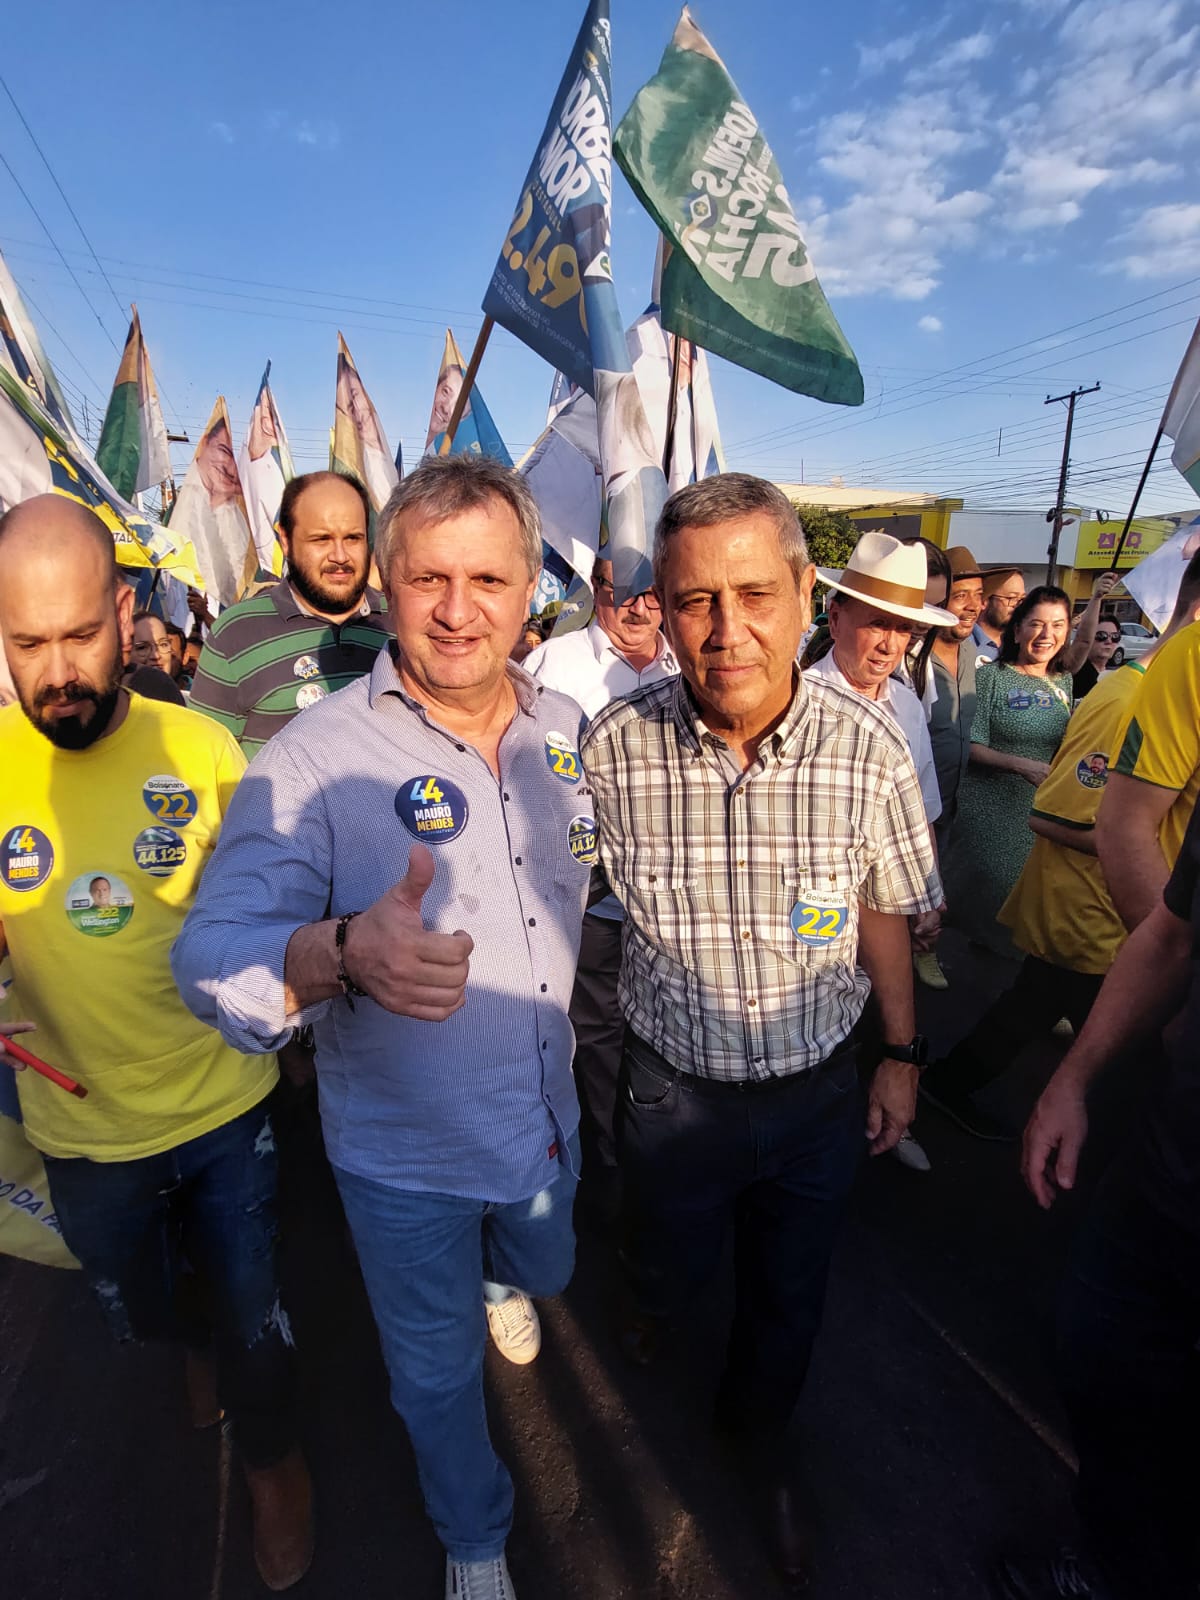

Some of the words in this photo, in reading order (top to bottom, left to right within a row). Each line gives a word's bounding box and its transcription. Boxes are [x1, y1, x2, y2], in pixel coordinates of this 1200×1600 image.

[549, 748, 580, 778] 22
[148, 781, 185, 789] Bolsonaro
[410, 777, 444, 805] 44
[151, 793, 193, 818] 22
[414, 806, 451, 821] MAURO
[416, 817, 455, 832] MENDES
[8, 828, 36, 853] 44
[8, 855, 39, 869] MAURO
[137, 846, 186, 865] 44.125
[8, 866, 39, 879] MENDES
[805, 893, 844, 904] Bolsonaro
[97, 907, 119, 919] 222
[797, 906, 841, 938] 22
[10, 1188, 44, 1215] DA
